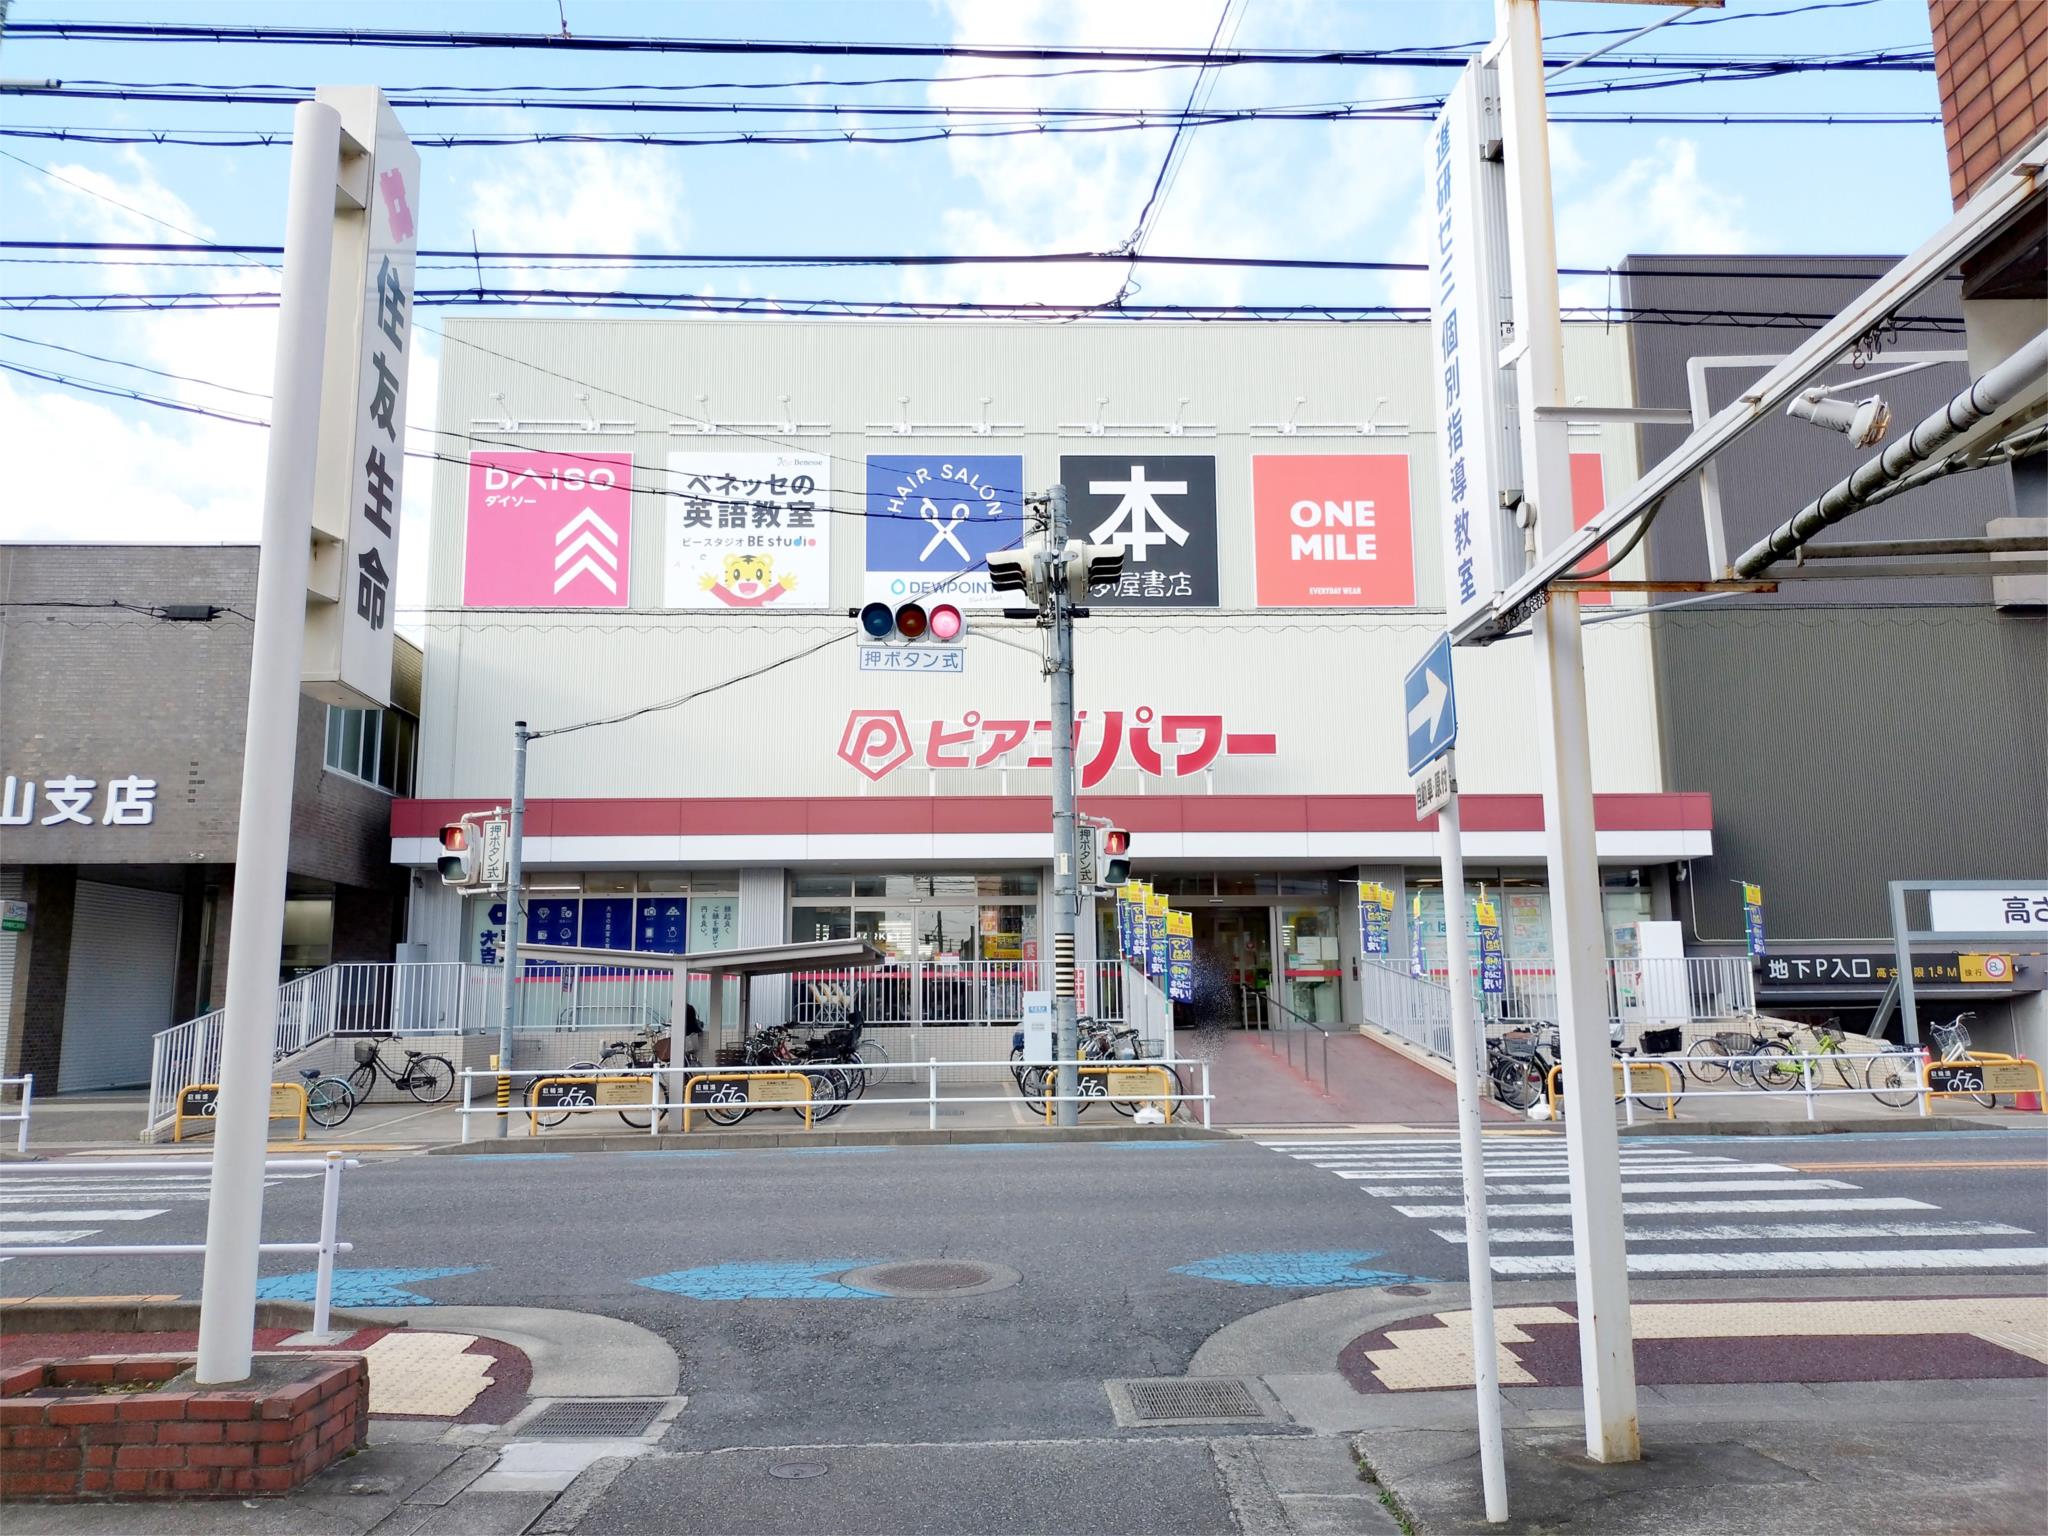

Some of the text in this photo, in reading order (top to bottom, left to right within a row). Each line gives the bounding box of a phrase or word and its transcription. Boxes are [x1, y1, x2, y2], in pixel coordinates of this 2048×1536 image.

[357, 254, 406, 632] 住友生命
[485, 467, 616, 492] DAISO
[687, 472, 816, 497] ベネッセの
[887, 464, 1003, 516] HAIR SALON
[485, 495, 537, 508] ダイソー
[1088, 465, 1190, 562] 本
[1289, 500, 1376, 528] ONE
[683, 500, 816, 529] 英語教室
[682, 535, 817, 547] ビースタジオ BE studio
[1290, 533, 1377, 560] MILE
[909, 581, 995, 594] DEWPOINT
[1309, 587, 1362, 595] EVERYDAY WEAR
[863, 650, 960, 670] 押ボタン式
[1768, 958, 1871, 980] 地下P入口
